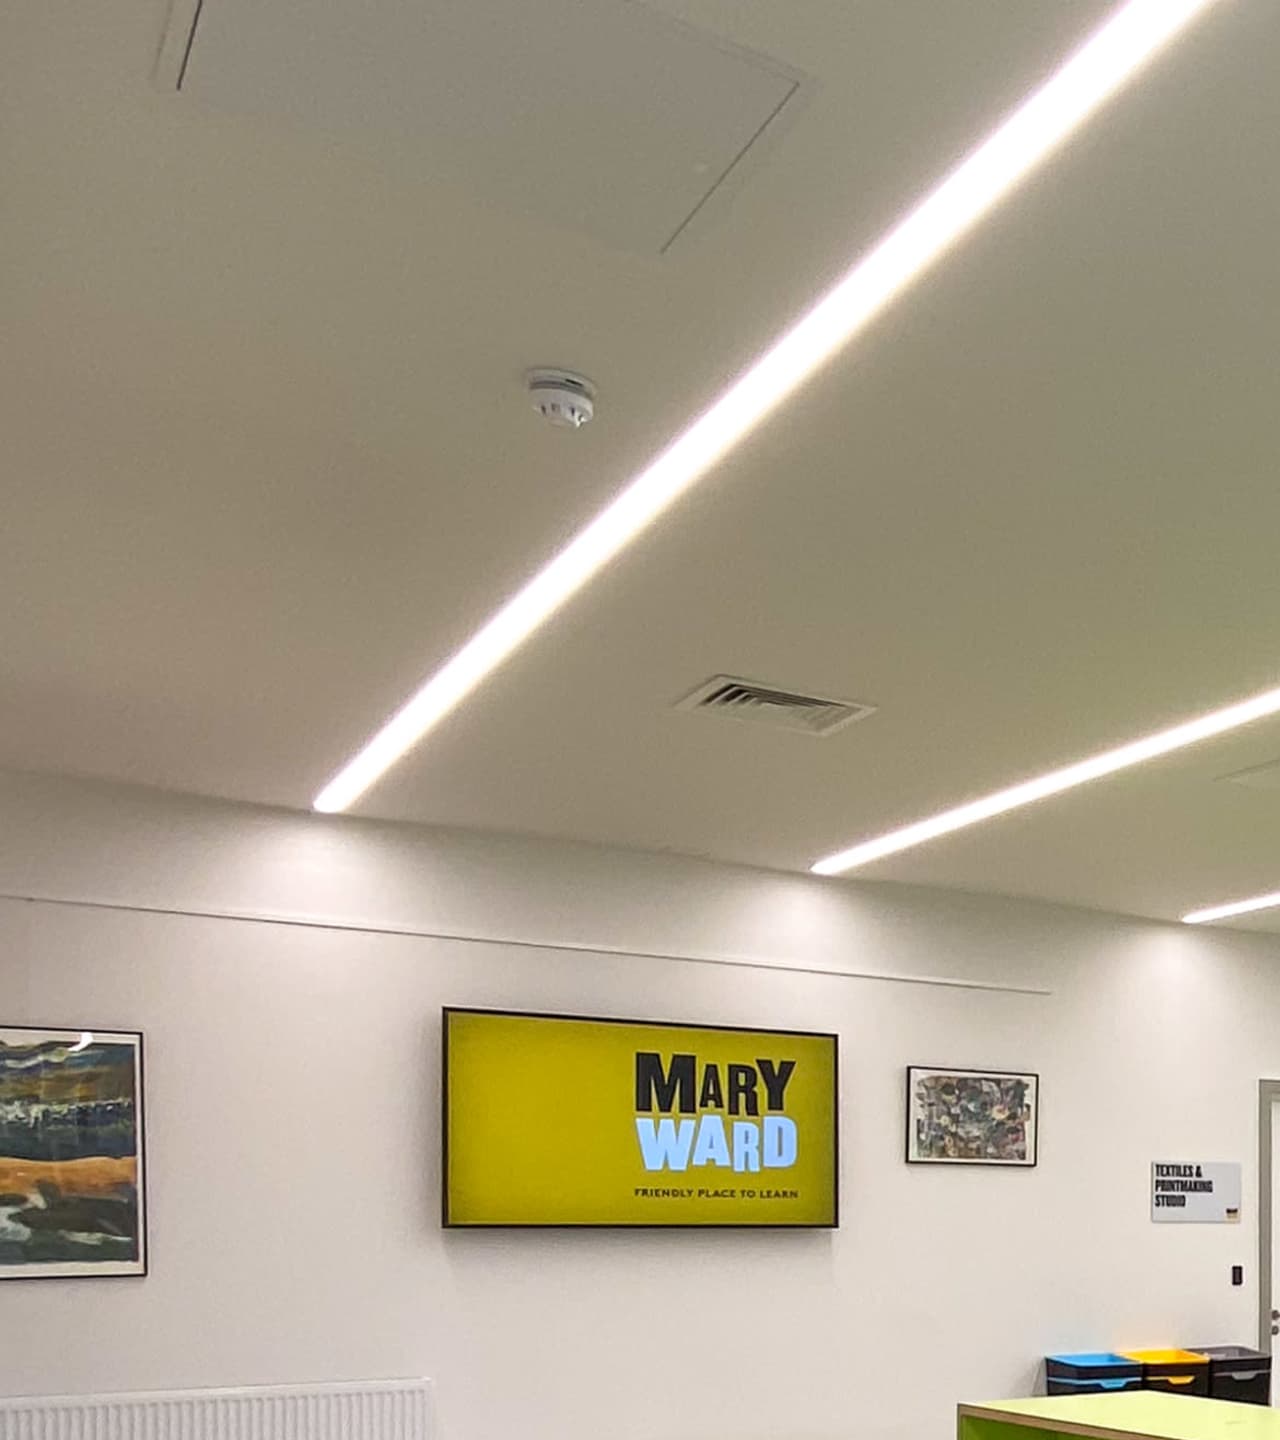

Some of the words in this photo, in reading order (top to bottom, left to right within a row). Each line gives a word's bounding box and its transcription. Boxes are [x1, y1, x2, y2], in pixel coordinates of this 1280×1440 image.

[635, 1052, 796, 1116] MARY
[635, 1114, 798, 1173] WARD
[1155, 1164, 1194, 1178] TEXTILES
[1195, 1165, 1202, 1177] &
[1155, 1180, 1213, 1193] PRINTMAKING
[634, 1188, 693, 1199] FRIENDLY
[697, 1188, 736, 1199] PLACE
[740, 1189, 756, 1199] TO
[759, 1189, 799, 1199] LEARN
[1155, 1194, 1186, 1207] STUDIO
